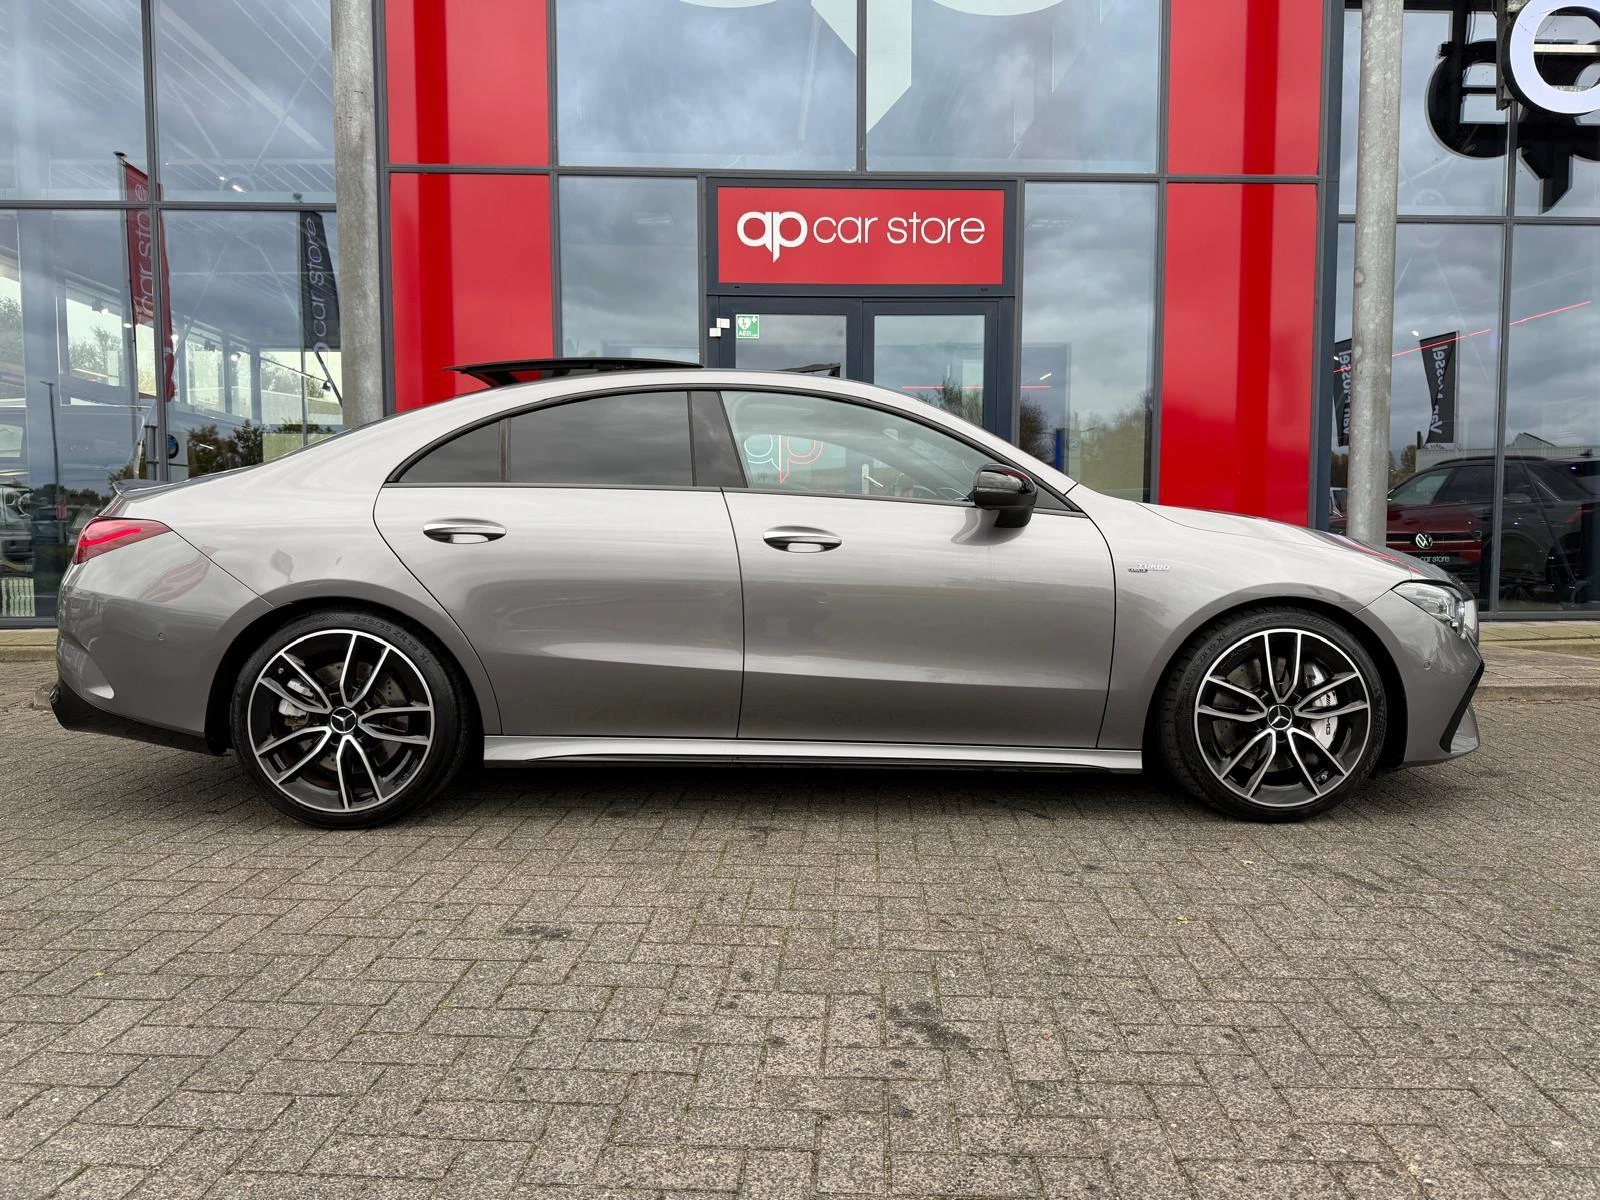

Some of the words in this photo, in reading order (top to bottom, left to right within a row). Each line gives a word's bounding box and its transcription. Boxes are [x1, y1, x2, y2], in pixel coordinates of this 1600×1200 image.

[306, 216, 325, 287] store
[736, 211, 808, 264] ap
[813, 216, 878, 244] car
[887, 211, 986, 245] store
[311, 290, 328, 338] car
[1432, 555, 1450, 563] store
